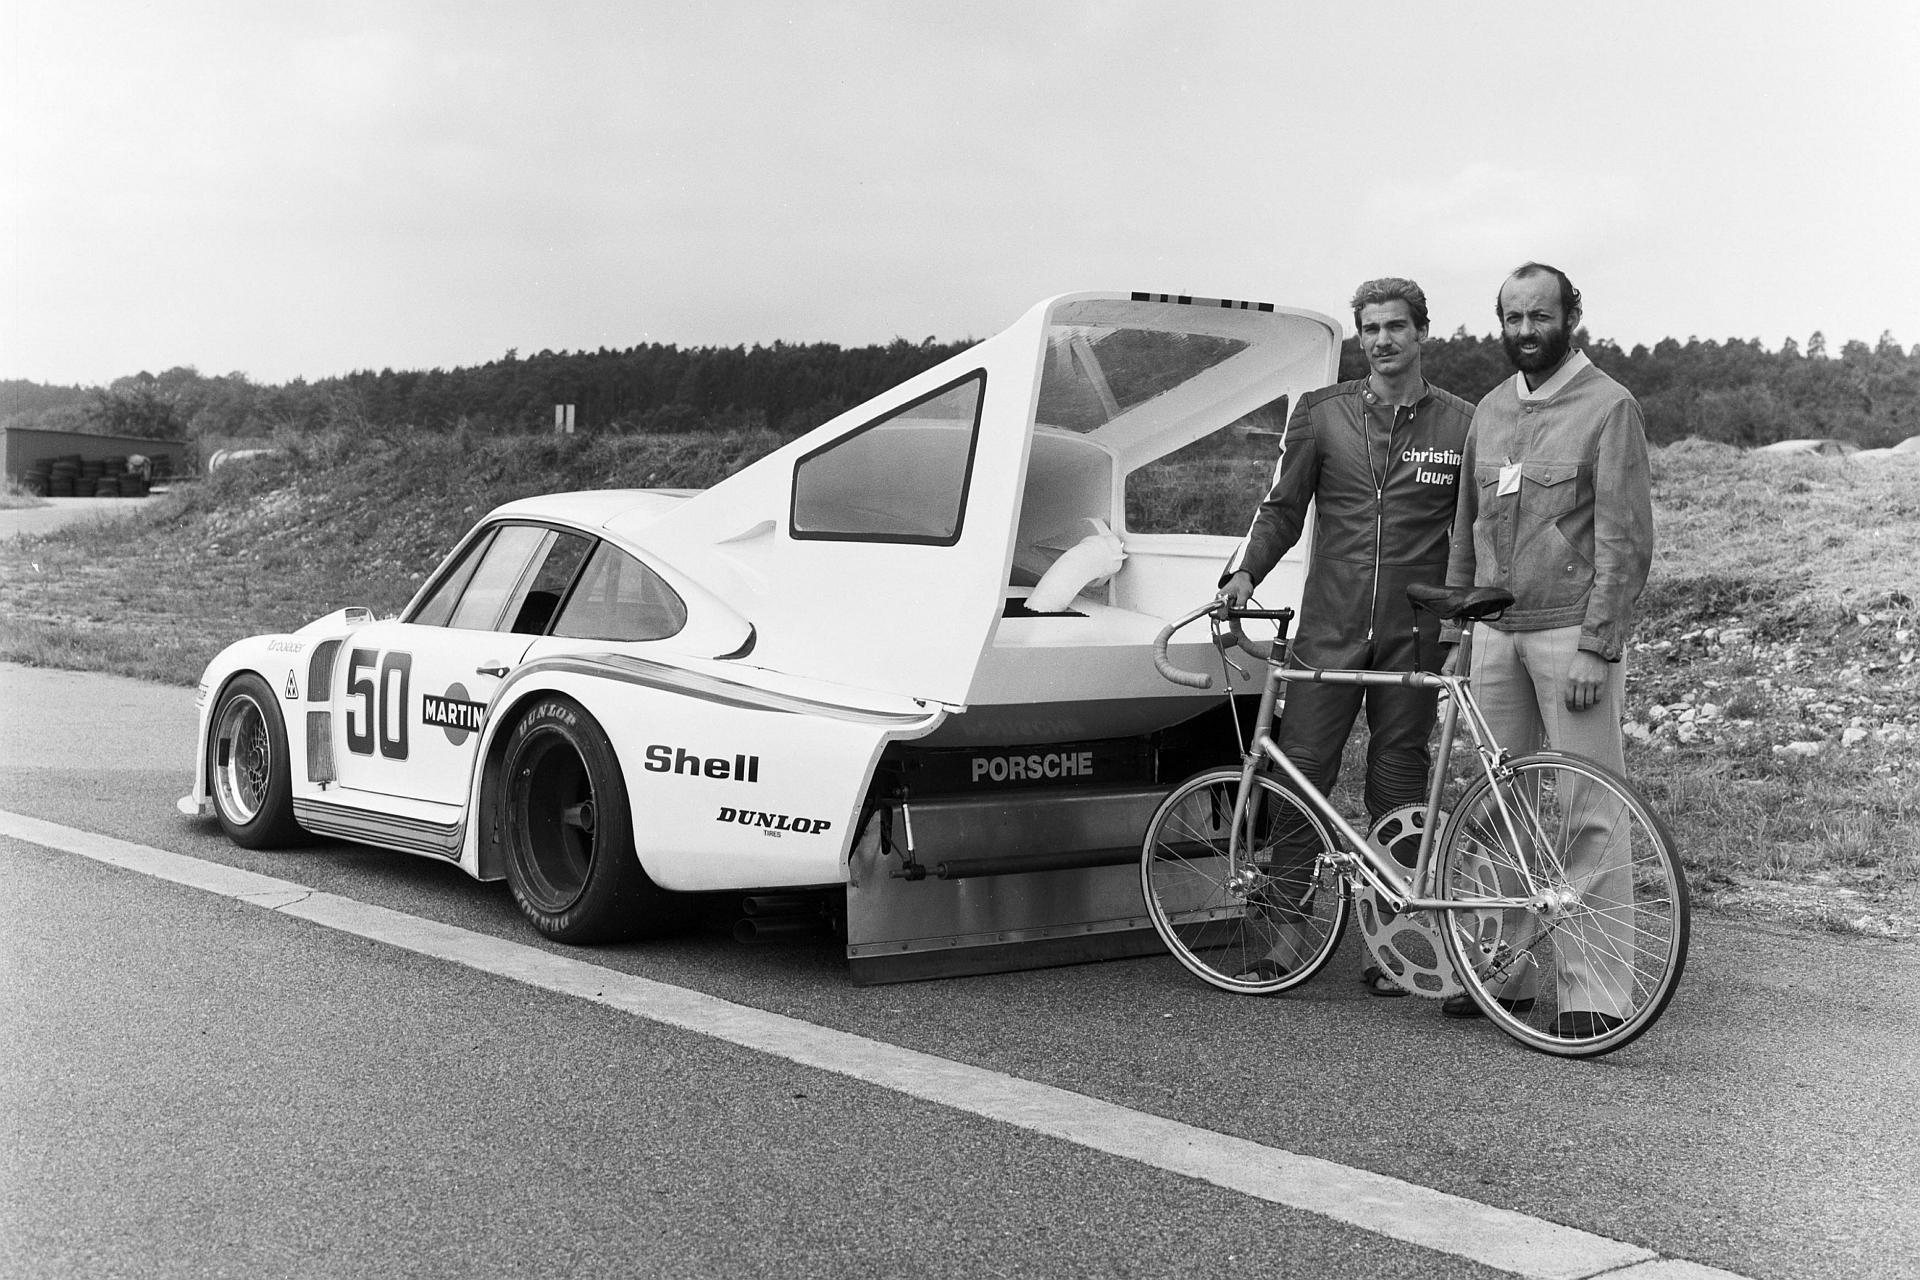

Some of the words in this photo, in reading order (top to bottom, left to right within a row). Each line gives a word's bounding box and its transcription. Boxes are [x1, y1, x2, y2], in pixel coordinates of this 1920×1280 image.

[1415, 467, 1454, 485] laure
[347, 648, 412, 760] 50
[644, 744, 759, 783] Shell
[972, 752, 1093, 782] PORSCHE
[716, 807, 832, 835] DUNLOP
[763, 830, 781, 838] TIRES
